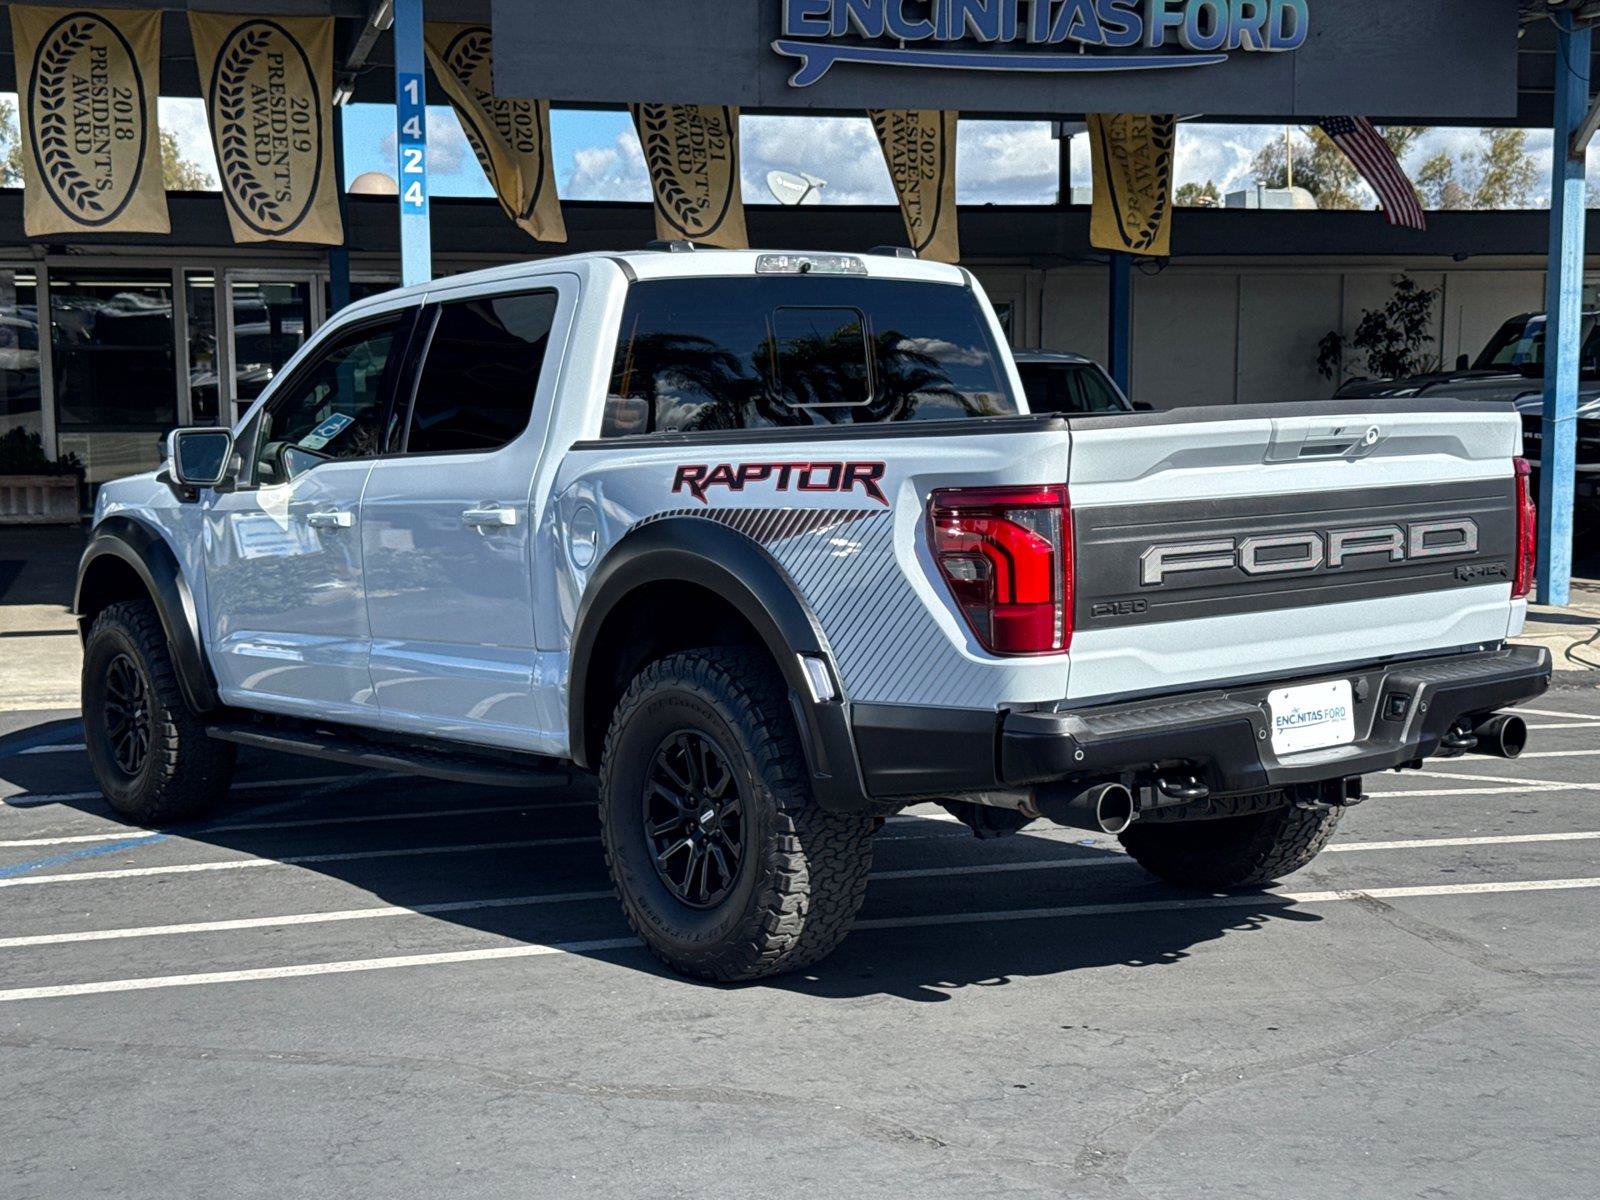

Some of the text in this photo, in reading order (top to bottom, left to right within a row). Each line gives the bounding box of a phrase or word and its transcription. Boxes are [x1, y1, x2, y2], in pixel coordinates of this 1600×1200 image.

[782, 0, 1310, 52] ENCINITAS FORD
[72, 74, 93, 155] AWARD
[90, 45, 114, 191] PRESIDENT'S
[112, 87, 135, 140] 2018
[251, 84, 272, 167] AWARD
[266, 52, 292, 202] PRESIDENT'S
[291, 98, 312, 153] 2019
[512, 101, 535, 154] 2020
[704, 116, 726, 161] 2021
[684, 104, 711, 209] ESIDENT'S
[892, 113, 908, 194] AWARD
[905, 110, 923, 229] ESIDENT'S
[920, 128, 937, 181] 2022
[671, 461, 890, 507] RAPTOR
[1139, 517, 1479, 588] FORD
[1276, 709, 1323, 727] ENCNITAS
[1324, 706, 1346, 719] FORD
